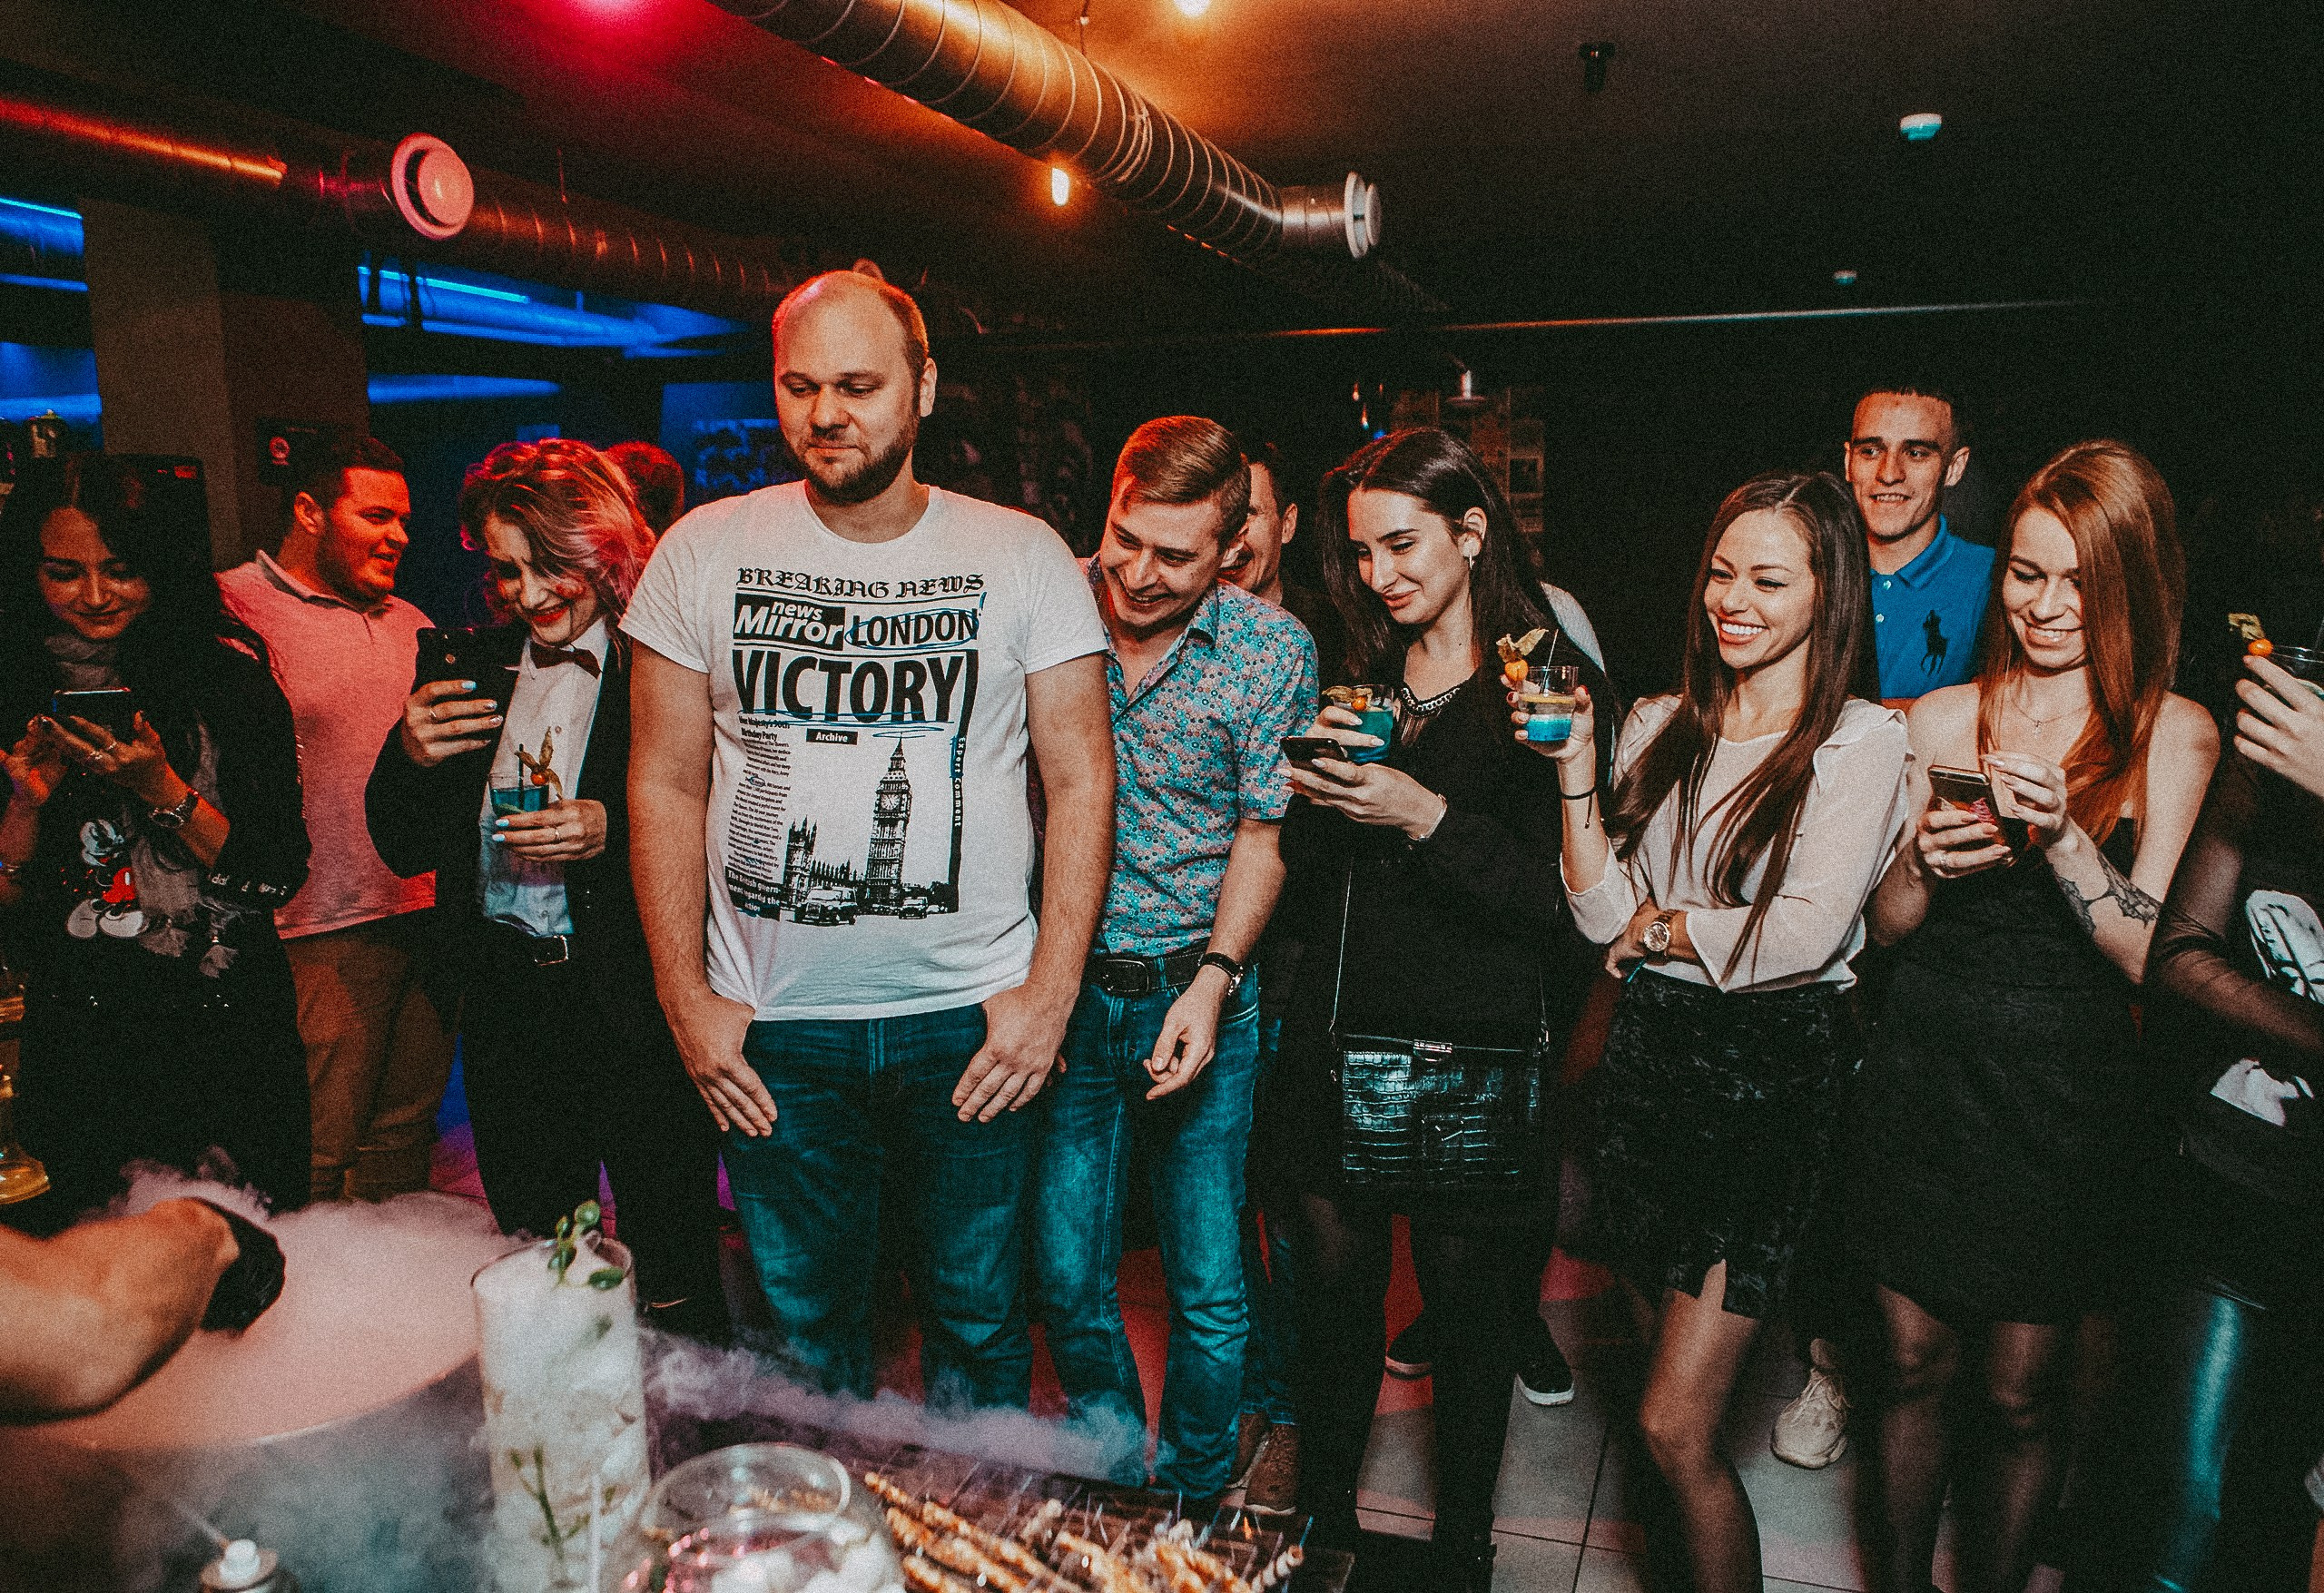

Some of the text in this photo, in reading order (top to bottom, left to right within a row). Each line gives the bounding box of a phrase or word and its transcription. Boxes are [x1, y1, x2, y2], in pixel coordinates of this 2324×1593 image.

[736, 567, 985, 599] BREAKING NEWS
[734, 605, 843, 644] Mirror
[772, 600, 822, 621] news
[851, 608, 978, 646] LONDON
[732, 650, 963, 723] VICTORY
[762, 731, 777, 742] Party
[816, 732, 848, 743] Archive
[954, 736, 966, 773] Expert
[767, 897, 780, 906] the
